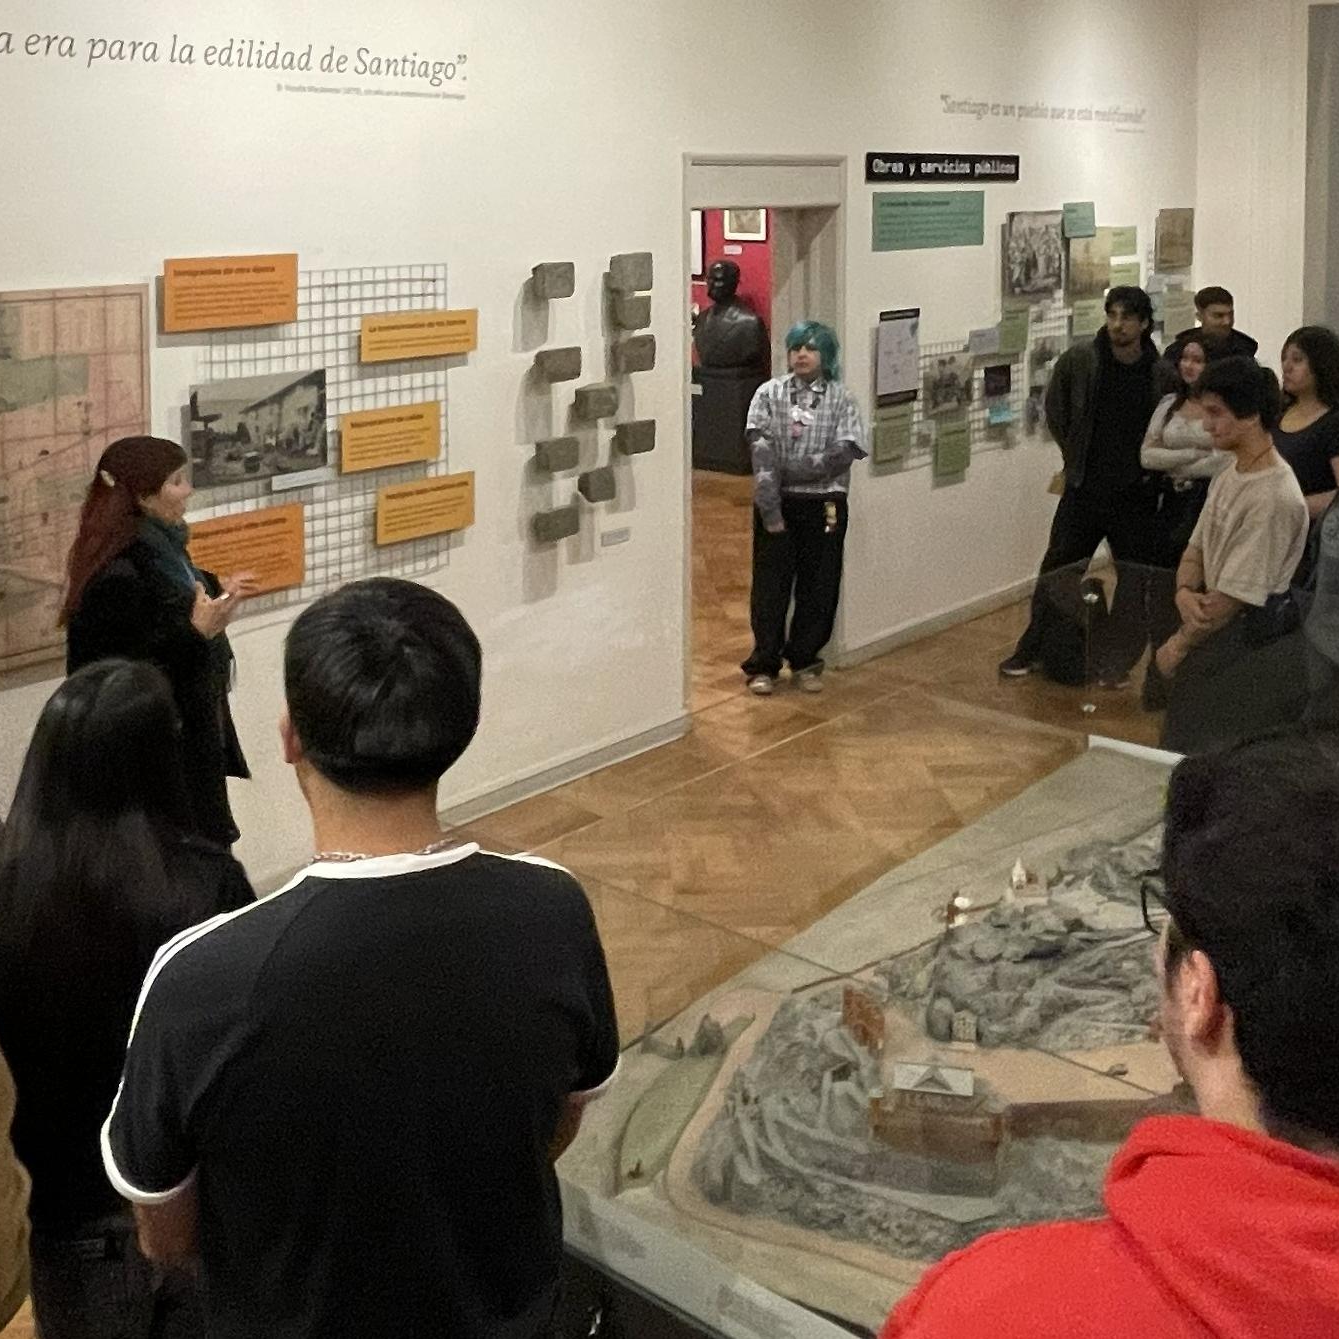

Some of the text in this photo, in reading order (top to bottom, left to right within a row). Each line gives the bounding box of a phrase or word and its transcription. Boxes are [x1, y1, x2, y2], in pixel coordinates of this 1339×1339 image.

[24, 32, 77, 58] era
[87, 36, 160, 68] para
[169, 34, 196, 65] la
[204, 38, 313, 72] edilidad
[320, 45, 348, 73] de
[872, 158, 1016, 177] Obras y servicios públicos
